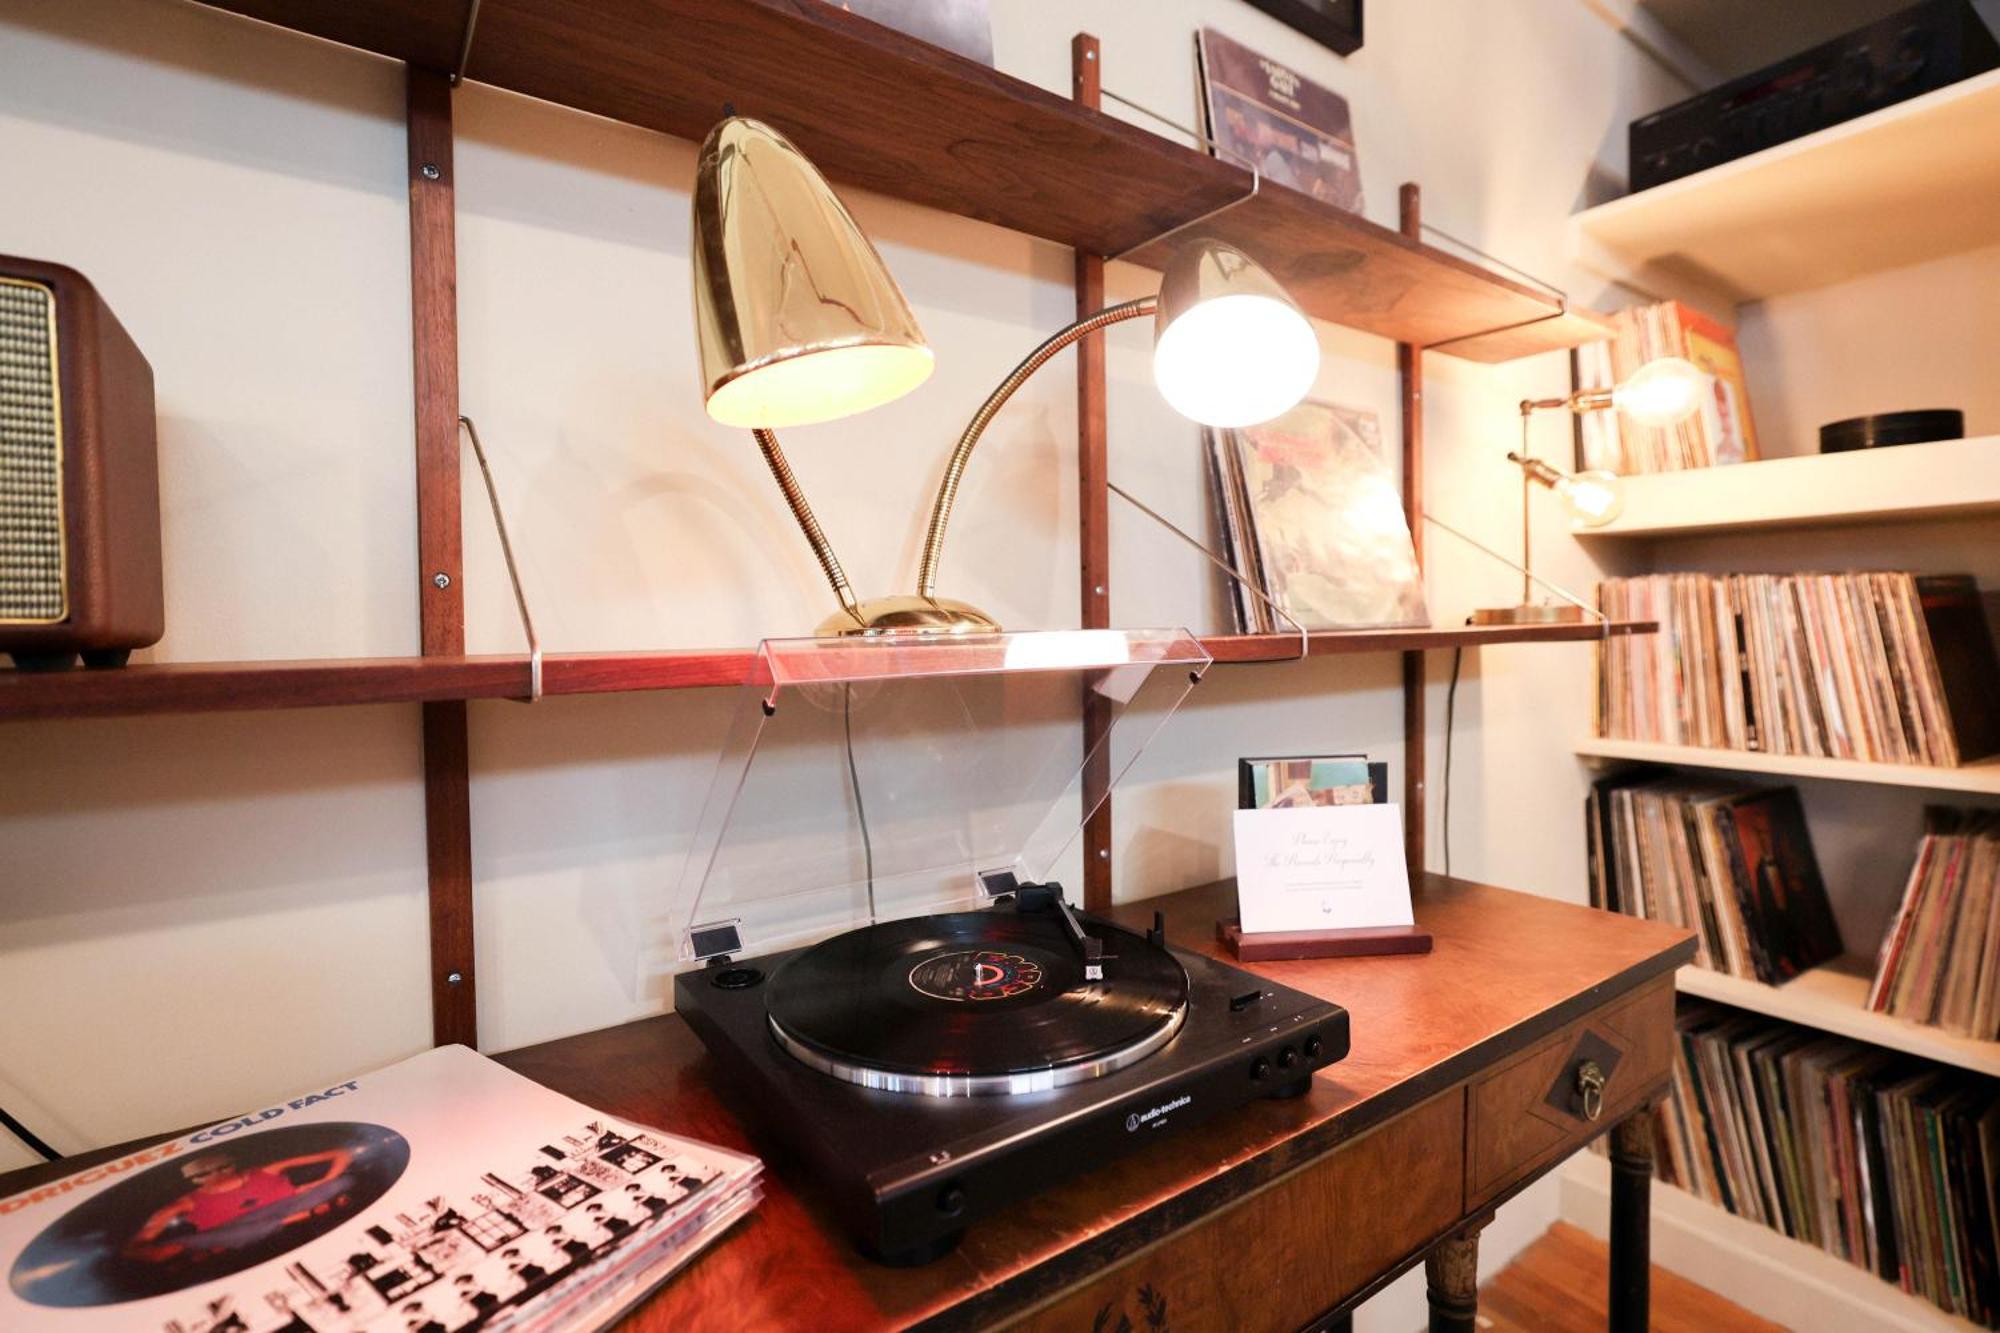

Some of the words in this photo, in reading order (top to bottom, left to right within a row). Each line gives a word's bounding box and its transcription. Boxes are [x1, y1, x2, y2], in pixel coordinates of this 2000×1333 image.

[189, 1107, 285, 1145] COLD
[288, 1080, 359, 1110] FACT
[1140, 1095, 1191, 1123] audio-technica
